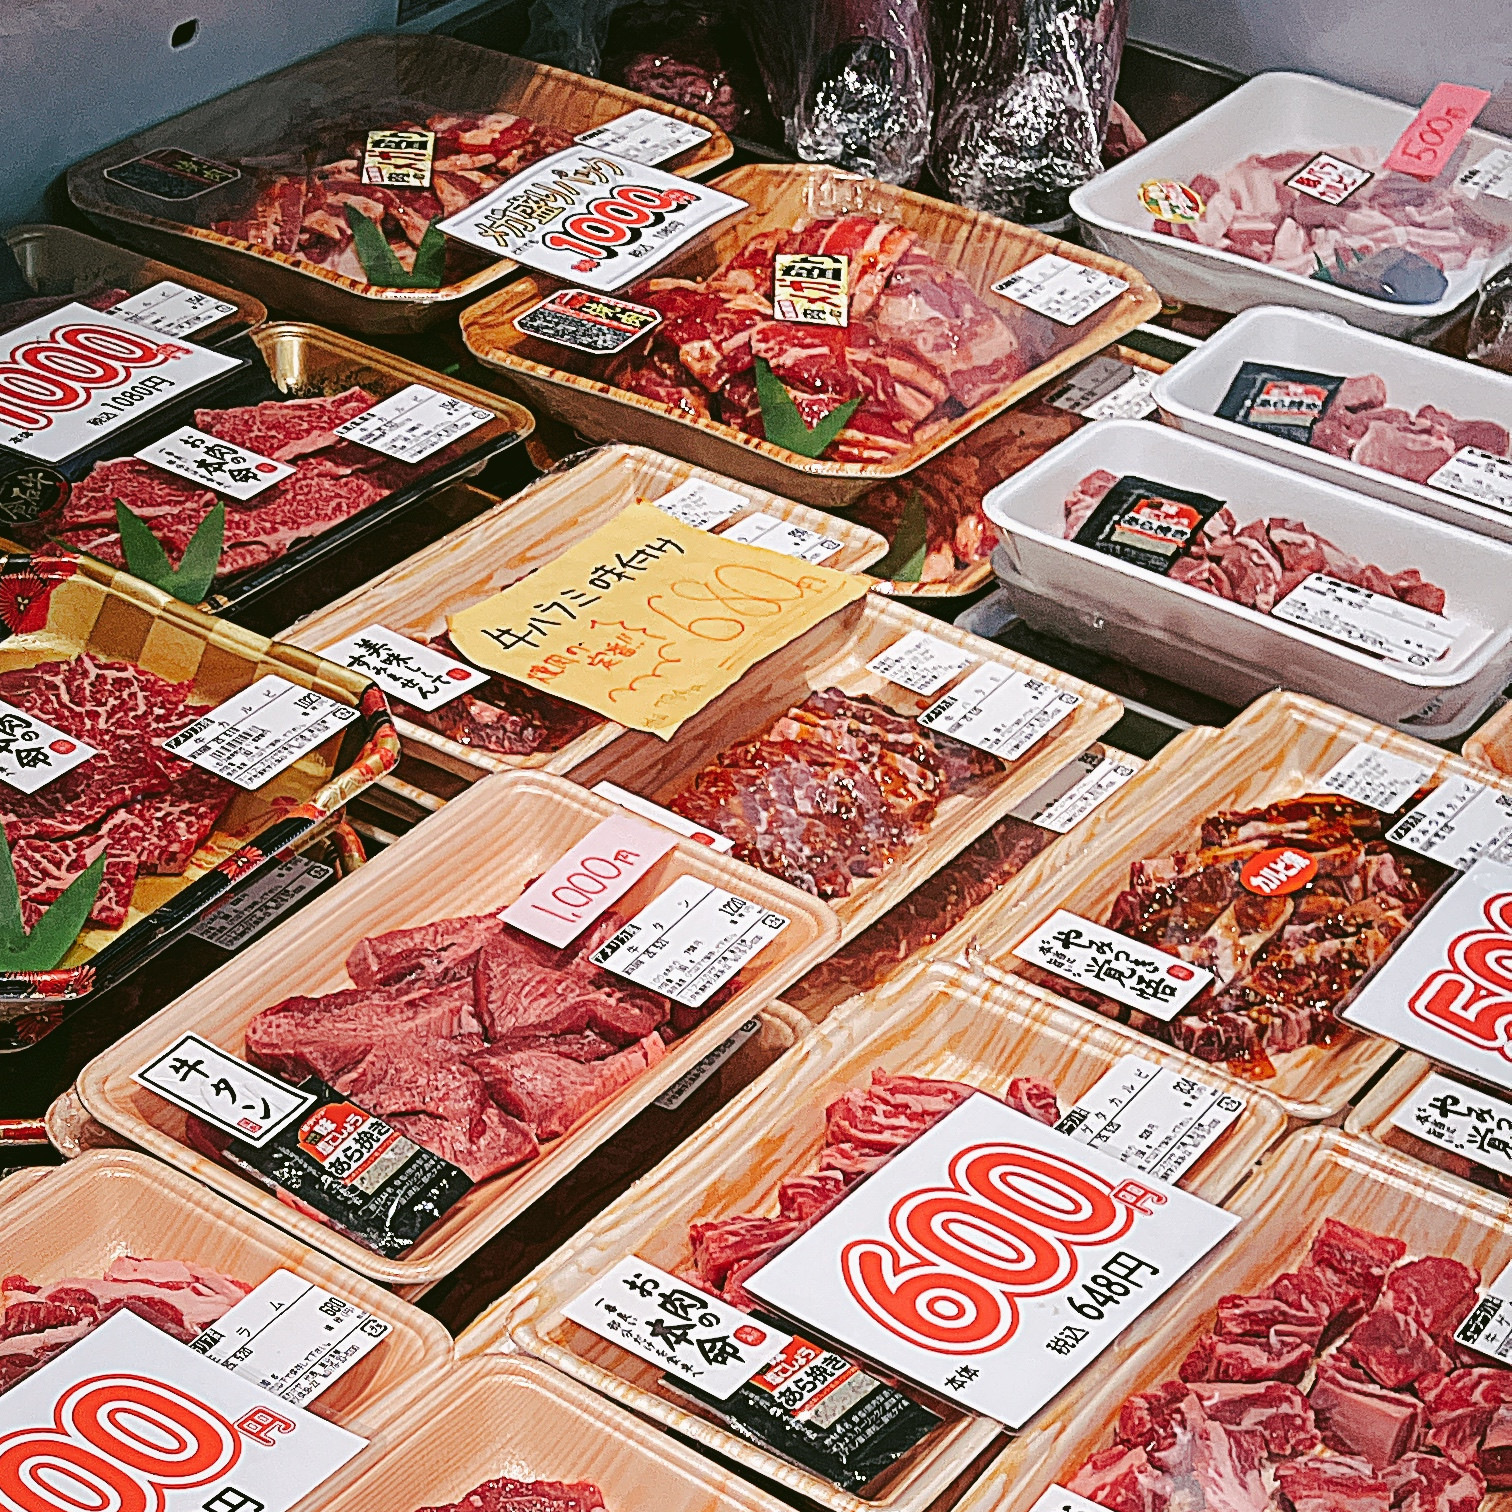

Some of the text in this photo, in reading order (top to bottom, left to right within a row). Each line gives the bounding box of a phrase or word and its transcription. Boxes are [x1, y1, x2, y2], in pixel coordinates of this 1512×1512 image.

[112, 375, 176, 420] 1080円
[168, 1054, 272, 1120] 牛タン
[325, 1118, 391, 1179] あら挽き
[319, 1297, 347, 1319] 680
[622, 1273, 721, 1329] お肉の
[1047, 1250, 1161, 1358] 税込 648円
[644, 1318, 746, 1367] 本命
[944, 1364, 983, 1393] 本体
